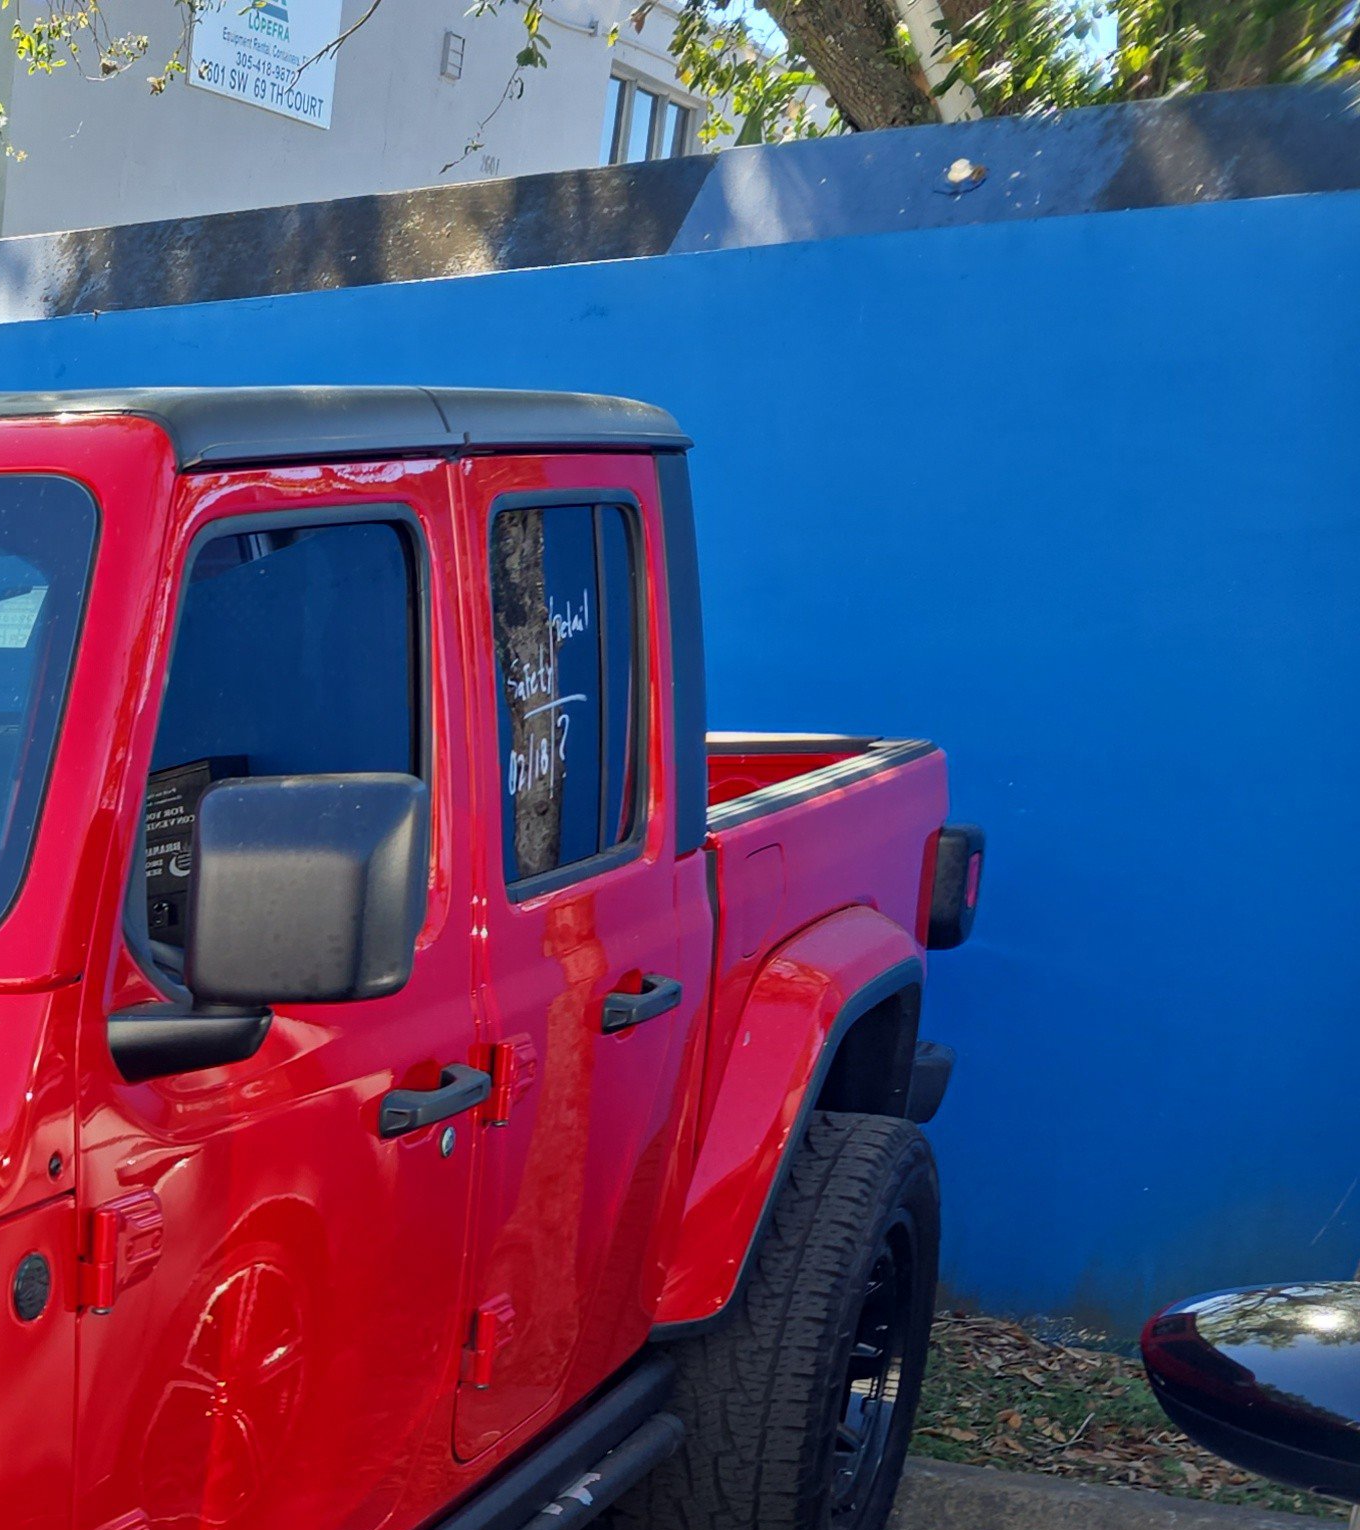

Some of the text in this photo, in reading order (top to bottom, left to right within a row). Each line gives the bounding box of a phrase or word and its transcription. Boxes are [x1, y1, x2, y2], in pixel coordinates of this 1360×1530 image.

[248, 12, 290, 42] LOPEFRA
[229, 68, 248, 93] SW
[254, 77, 267, 100] 69
[270, 82, 285, 107] TH
[286, 88, 324, 118] COURT
